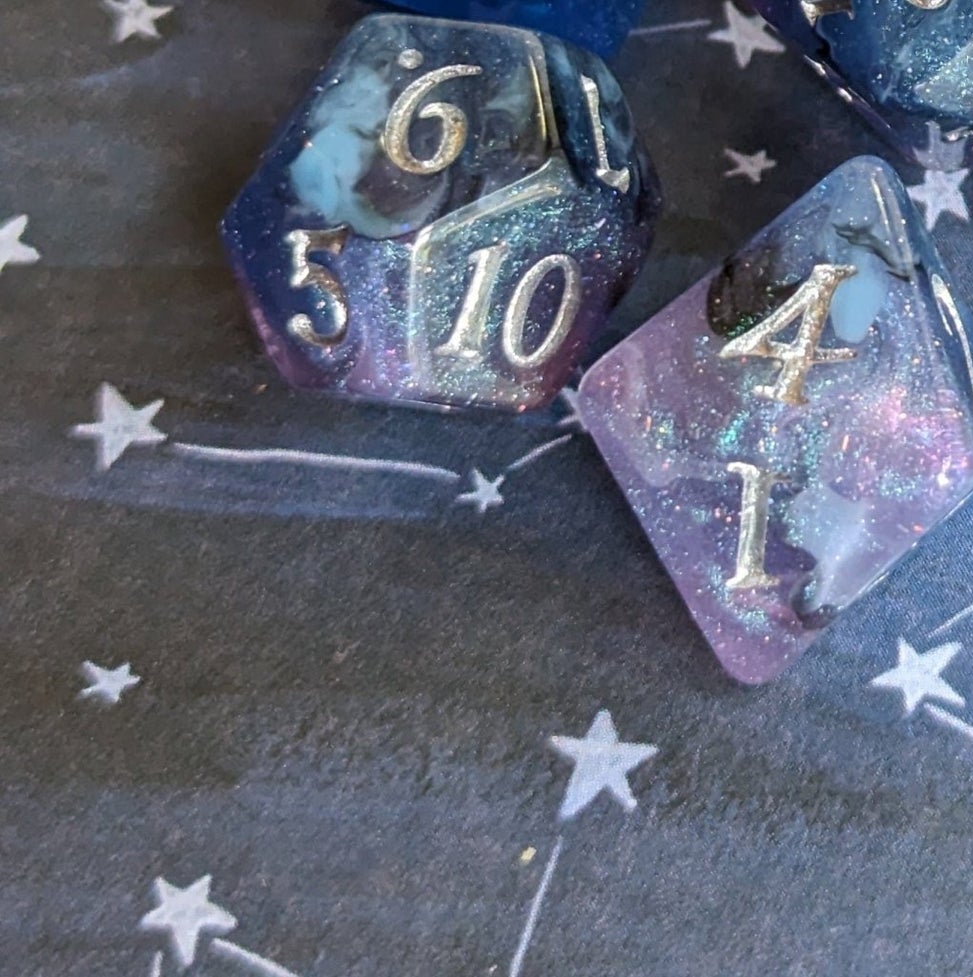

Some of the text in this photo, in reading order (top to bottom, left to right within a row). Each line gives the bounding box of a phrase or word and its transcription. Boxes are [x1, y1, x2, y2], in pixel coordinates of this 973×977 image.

[580, 75, 630, 194] 1
[286, 225, 348, 348] 5
[434, 240, 581, 369] 10
[719, 264, 858, 406] 4
[725, 461, 794, 589] 1
